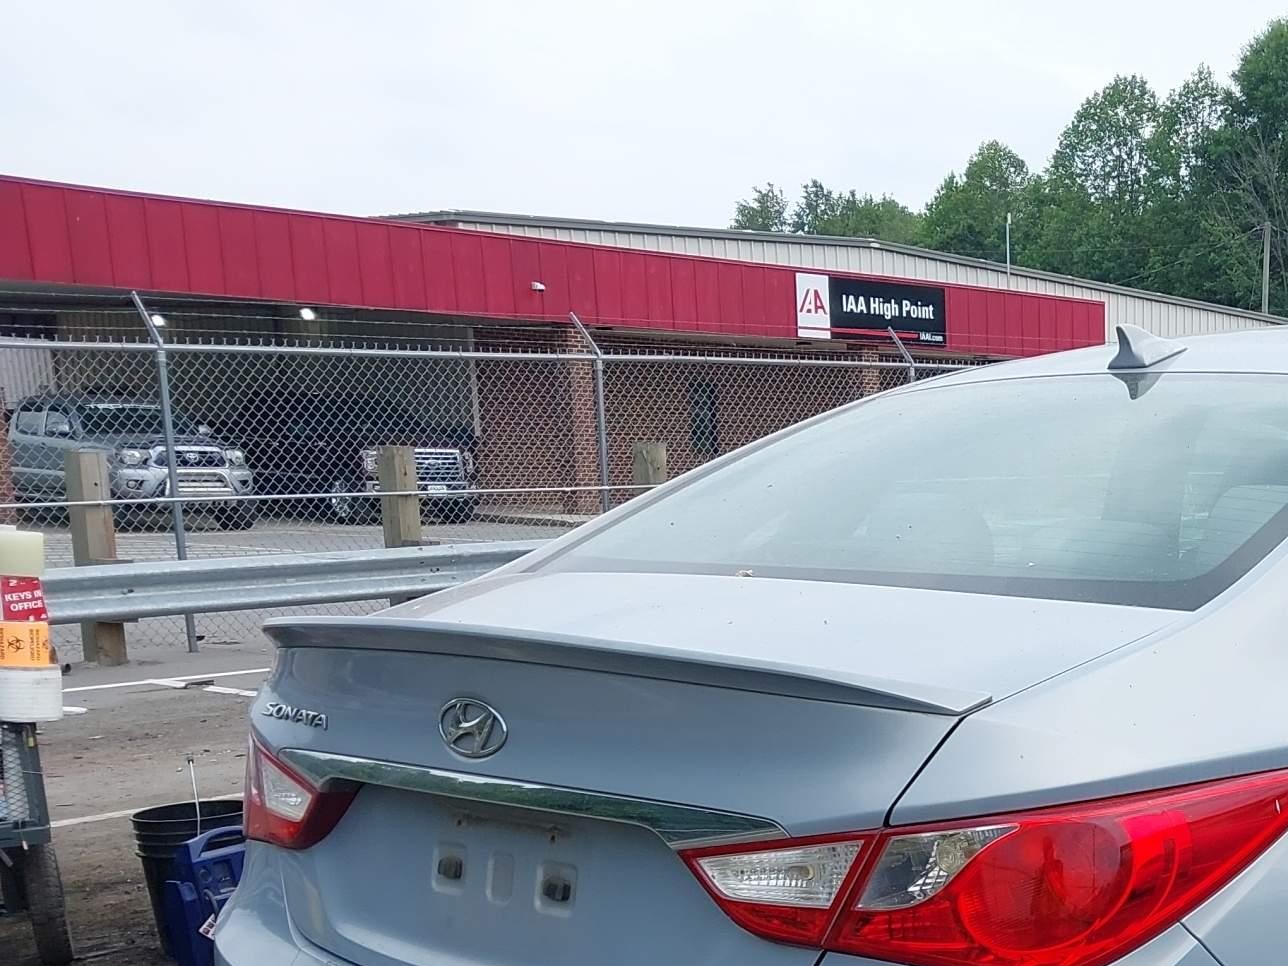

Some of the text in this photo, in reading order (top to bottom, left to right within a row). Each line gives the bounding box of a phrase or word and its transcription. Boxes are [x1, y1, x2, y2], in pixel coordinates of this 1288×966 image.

[842, 294, 935, 320] IAA High Point
[4, 591, 32, 601] KEYS
[10, 600, 43, 611] OFFICE
[262, 702, 328, 730] SONATA
